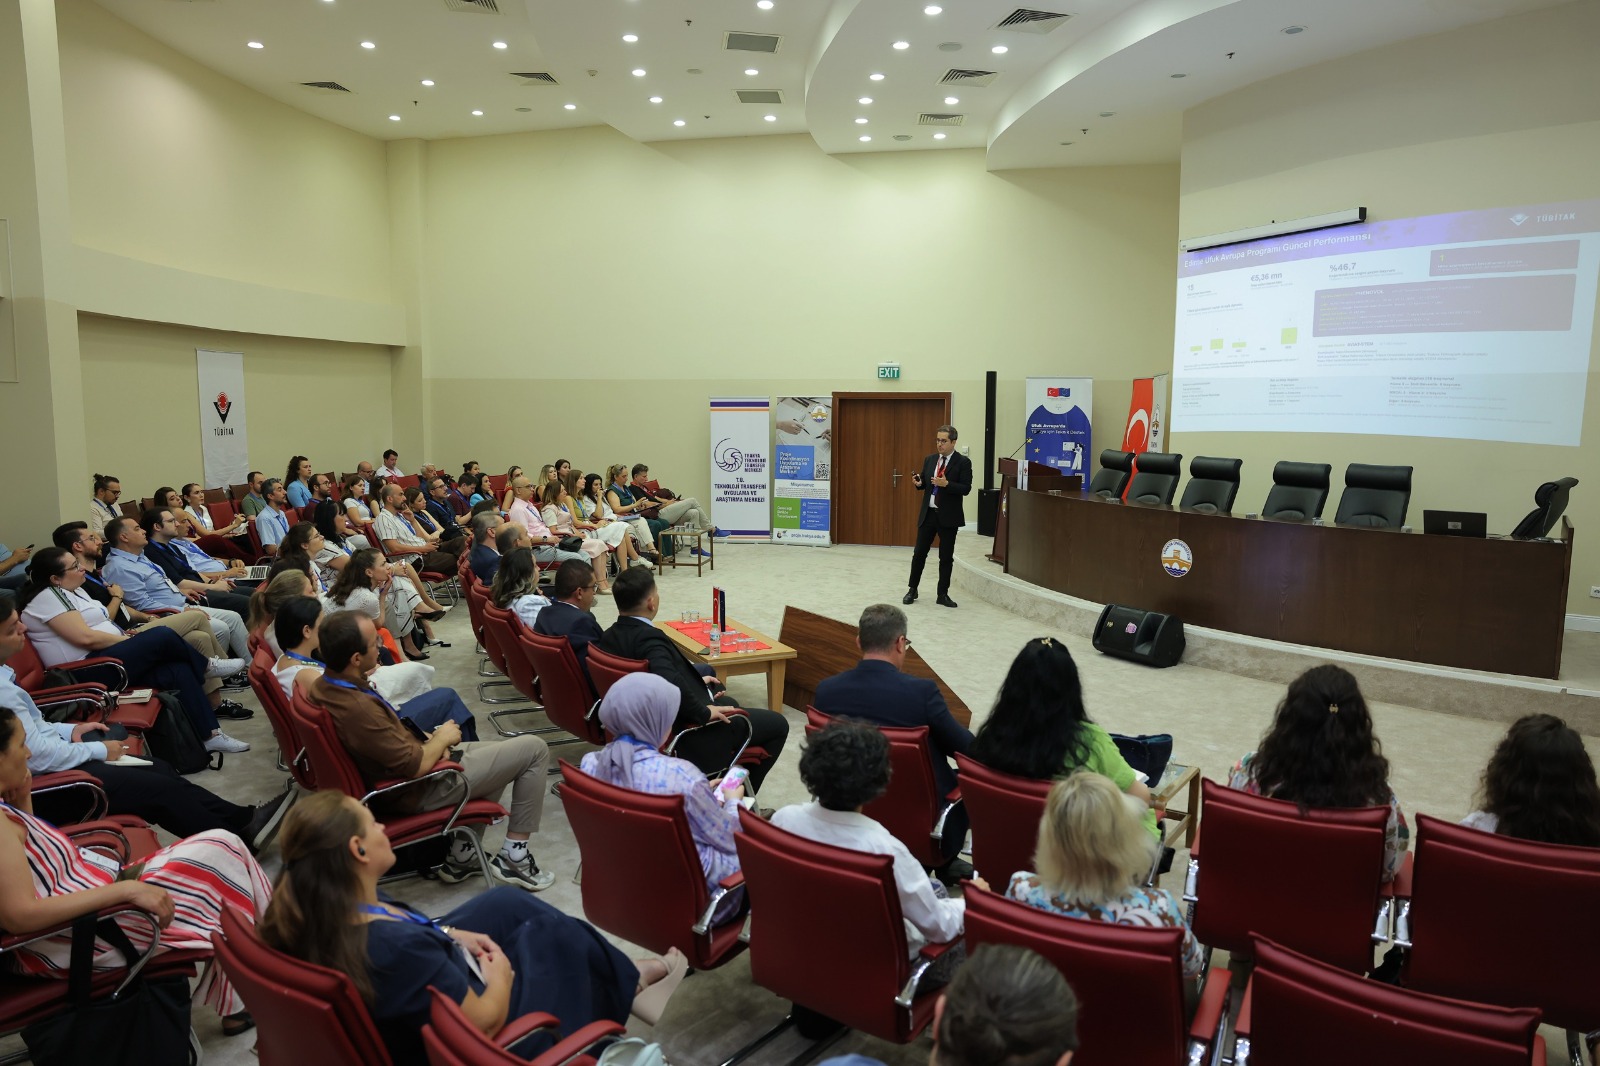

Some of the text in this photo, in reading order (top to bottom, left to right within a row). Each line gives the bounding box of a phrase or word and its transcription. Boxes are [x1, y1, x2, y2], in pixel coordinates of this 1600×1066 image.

[1536, 212, 1576, 223] TÜBİTAK
[1205, 253, 1220, 264] Ufuk
[1221, 250, 1245, 262] Avrupa
[1247, 246, 1281, 258] Programı
[1282, 240, 1312, 252] Güncel
[1313, 232, 1371, 247] Performansı
[1329, 262, 1357, 273] %46,7
[879, 367, 899, 378] EXIT
[214, 427, 234, 436] TÜBİTAK
